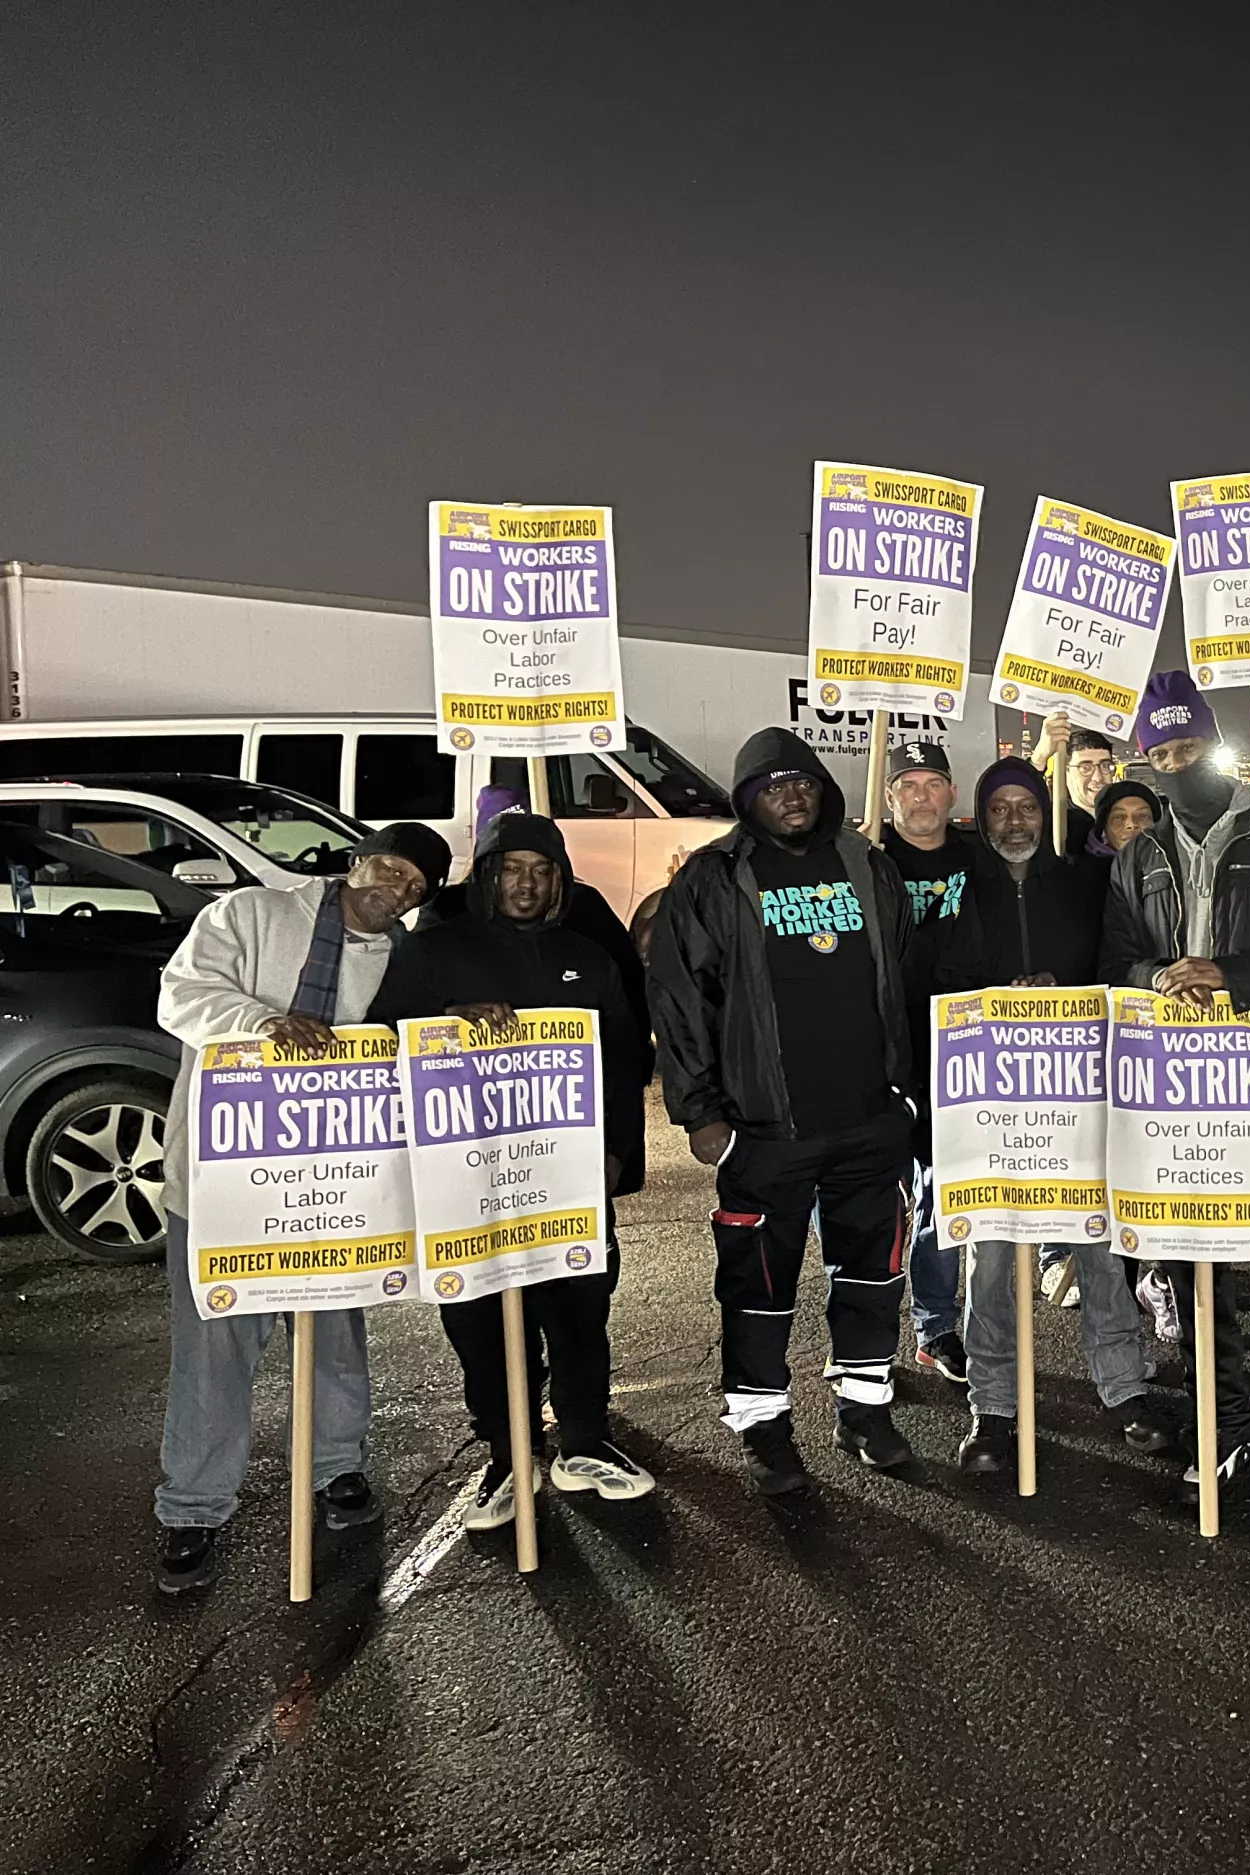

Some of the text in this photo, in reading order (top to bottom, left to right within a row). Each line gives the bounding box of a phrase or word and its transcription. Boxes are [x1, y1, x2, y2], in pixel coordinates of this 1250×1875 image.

[874, 481, 966, 512] SWISSPORT CARGO
[499, 519, 596, 538] SWISSPORT CARGO
[873, 507, 965, 538] WORKERS
[499, 546, 597, 567] WORKERS
[827, 527, 965, 584] ON STRIKE
[1079, 543, 1161, 582] WORKERS
[1187, 530, 1220, 569] ON
[449, 567, 599, 615] ON STRIKE
[854, 588, 940, 617] For Fair
[1031, 552, 1157, 623] ON STRIKE
[872, 622, 916, 649] Pay!
[10, 671, 21, 717] 3136
[540, 1021, 583, 1040] CARGO
[991, 1026, 1100, 1045] WORKERS
[472, 1050, 583, 1076] WORKERS
[946, 1051, 1102, 1099] ON STRIKE
[272, 1069, 399, 1092] WORKERS
[1118, 1056, 1154, 1104] ON
[425, 1075, 584, 1138] ON STRIKE
[211, 1095, 406, 1153] ON STRIKE
[1003, 1133, 1053, 1148] Labor
[1173, 1145, 1226, 1161] Labor
[989, 1154, 1068, 1171] Practices
[480, 1190, 547, 1215] Practices
